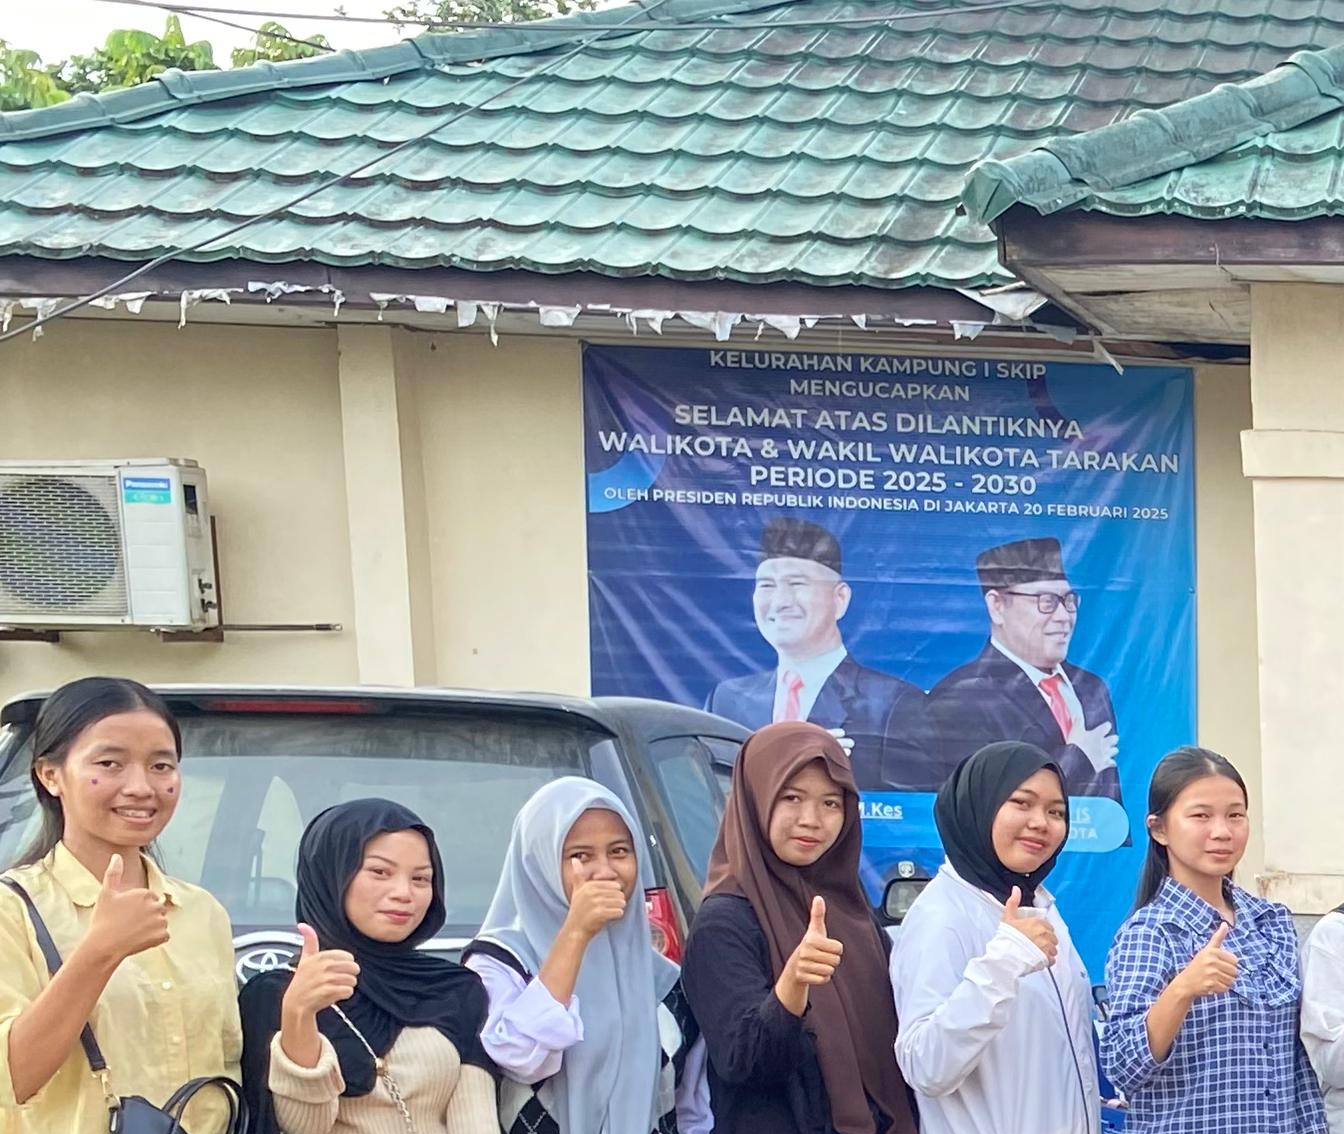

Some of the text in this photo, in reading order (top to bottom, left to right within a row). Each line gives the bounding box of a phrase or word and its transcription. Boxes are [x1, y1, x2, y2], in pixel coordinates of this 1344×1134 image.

[710, 351, 1047, 380] KELURAHAN KAMPUNG I SKIP
[790, 379, 970, 401] MENGUCAPKAN
[675, 404, 1084, 439] SELAMAT ATAS DILANTIKNYA
[599, 431, 1179, 473] WALIKOTA & WAKIL WALIKOTA TARAKAN
[750, 466, 875, 490] PERIODE
[883, 471, 946, 492] 2025
[971, 474, 1036, 495] 2030
[604, 487, 1169, 520] OLEH PRESIDEN REPUBLIK INDONESIA DI JAKARTA 20 FEBRUARI 2025
